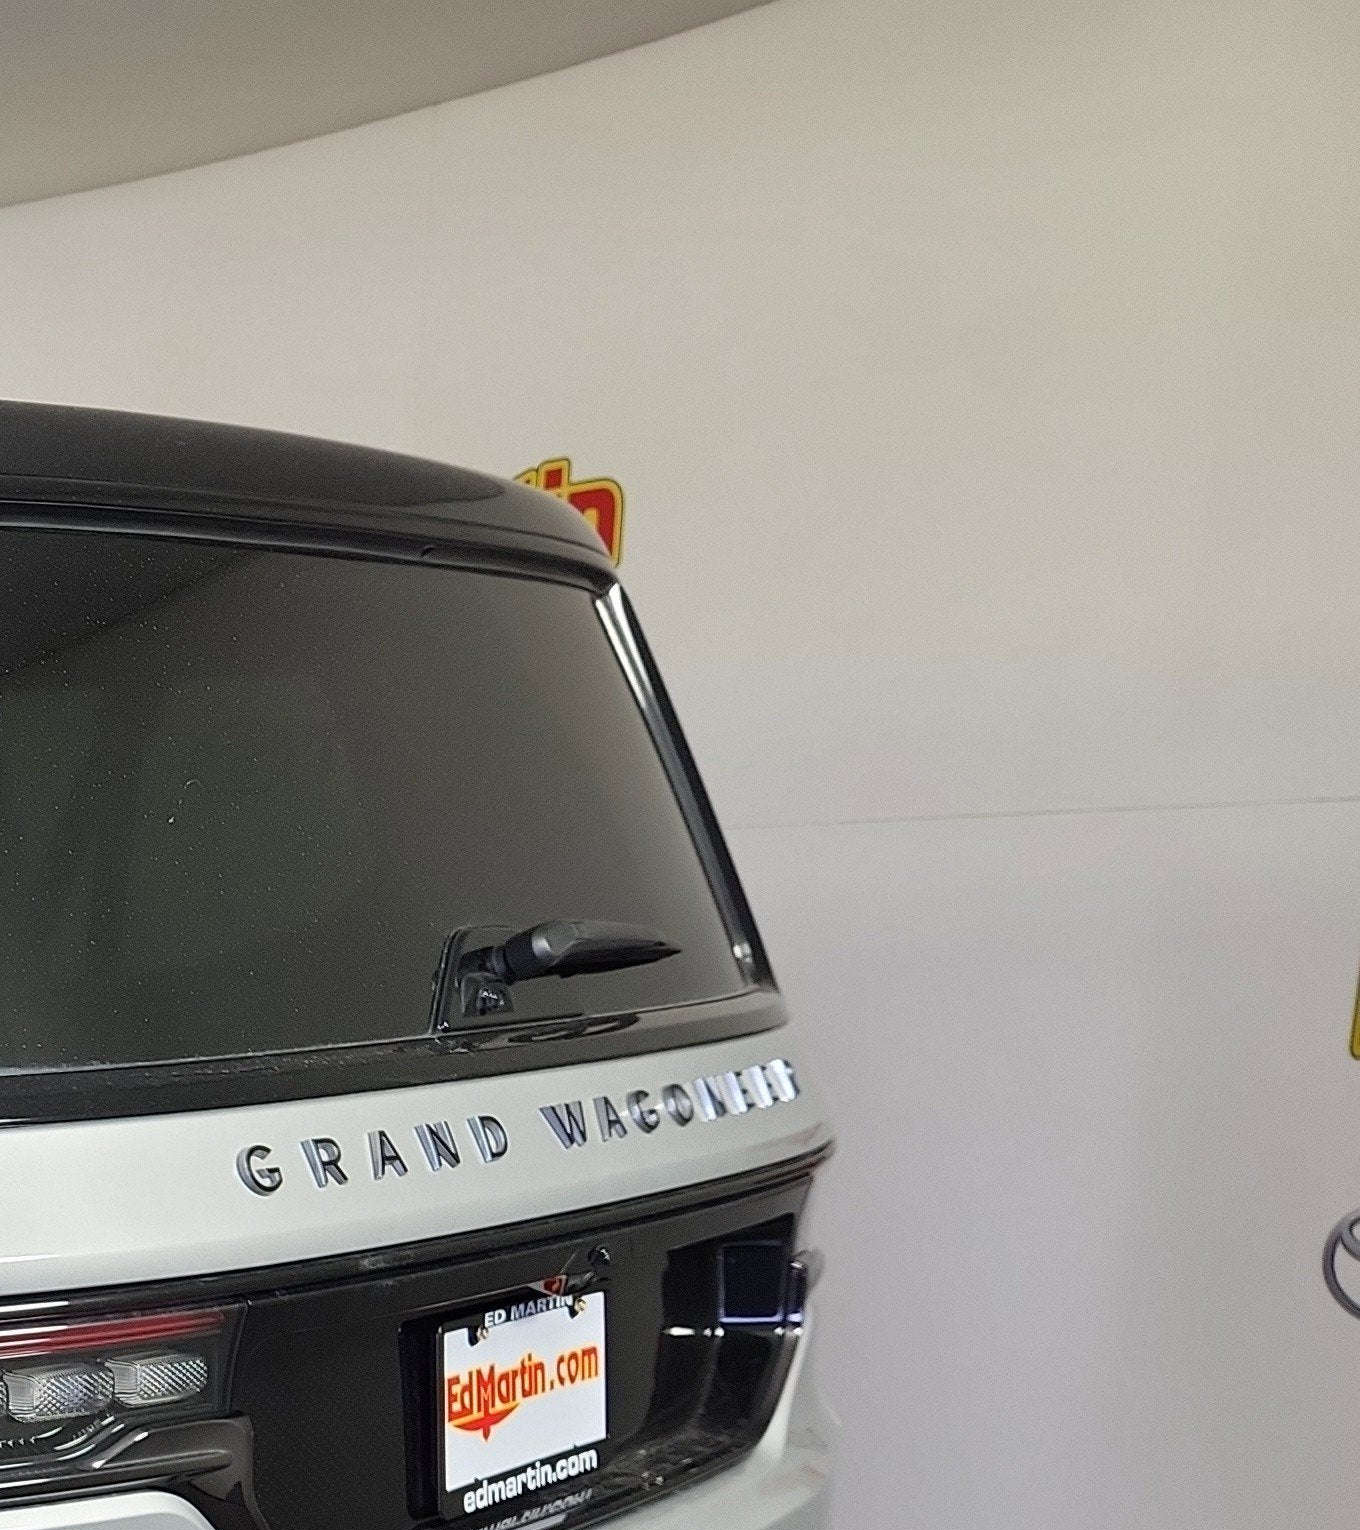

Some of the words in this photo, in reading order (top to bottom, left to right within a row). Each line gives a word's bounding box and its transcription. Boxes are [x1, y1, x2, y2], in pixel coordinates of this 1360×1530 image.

[236, 1115, 509, 1197] GRAND
[484, 1308, 507, 1328] ED
[510, 1295, 575, 1322] MARTIN
[463, 1448, 599, 1514] edmartin.com
